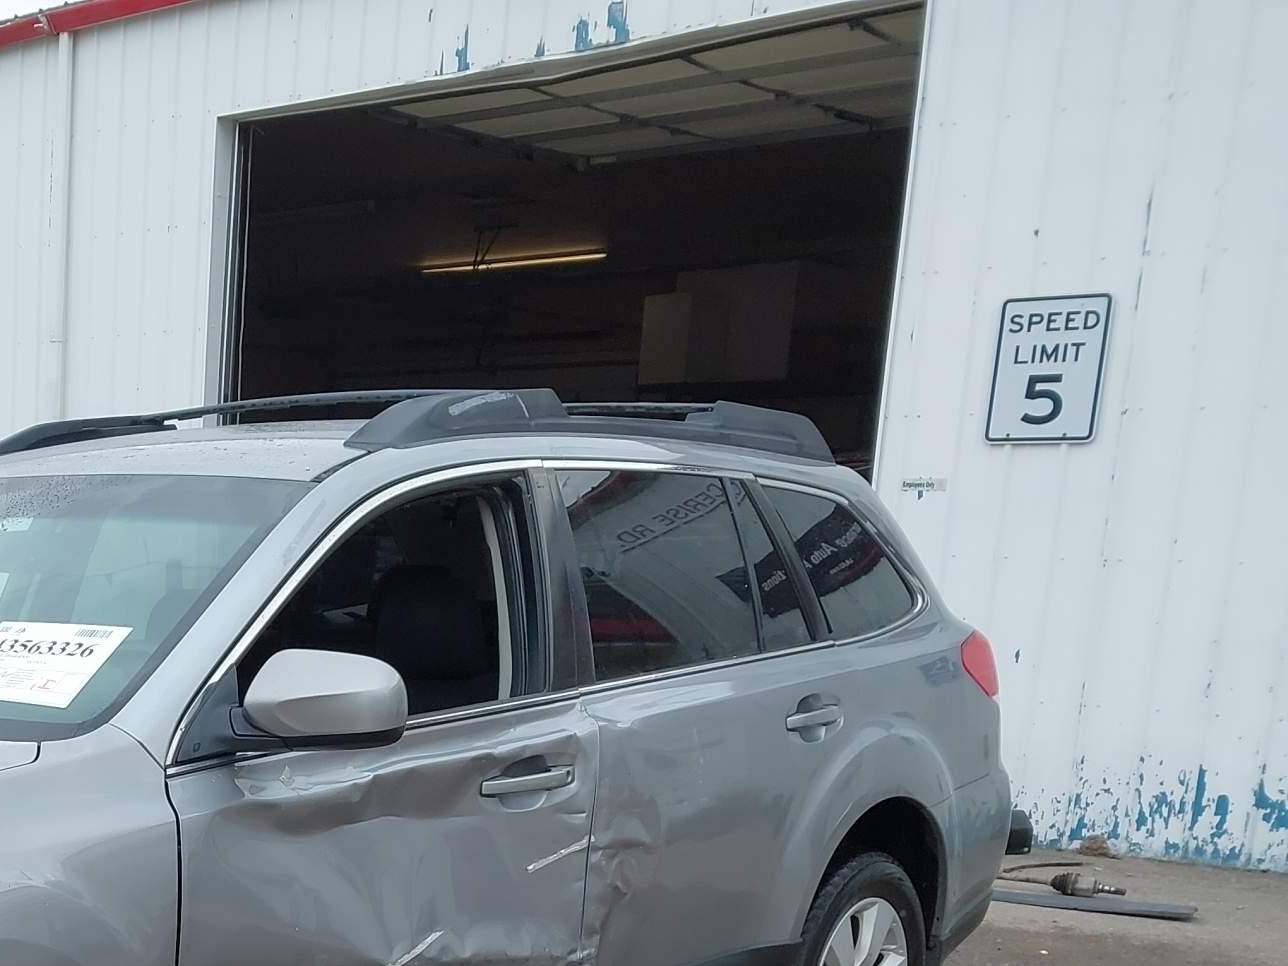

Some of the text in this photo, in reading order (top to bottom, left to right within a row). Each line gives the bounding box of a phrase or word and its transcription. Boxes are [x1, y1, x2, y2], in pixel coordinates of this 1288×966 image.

[1008, 310, 1101, 334] SPEED
[1013, 342, 1086, 364] LIMIT
[1020, 373, 1064, 425] 5
